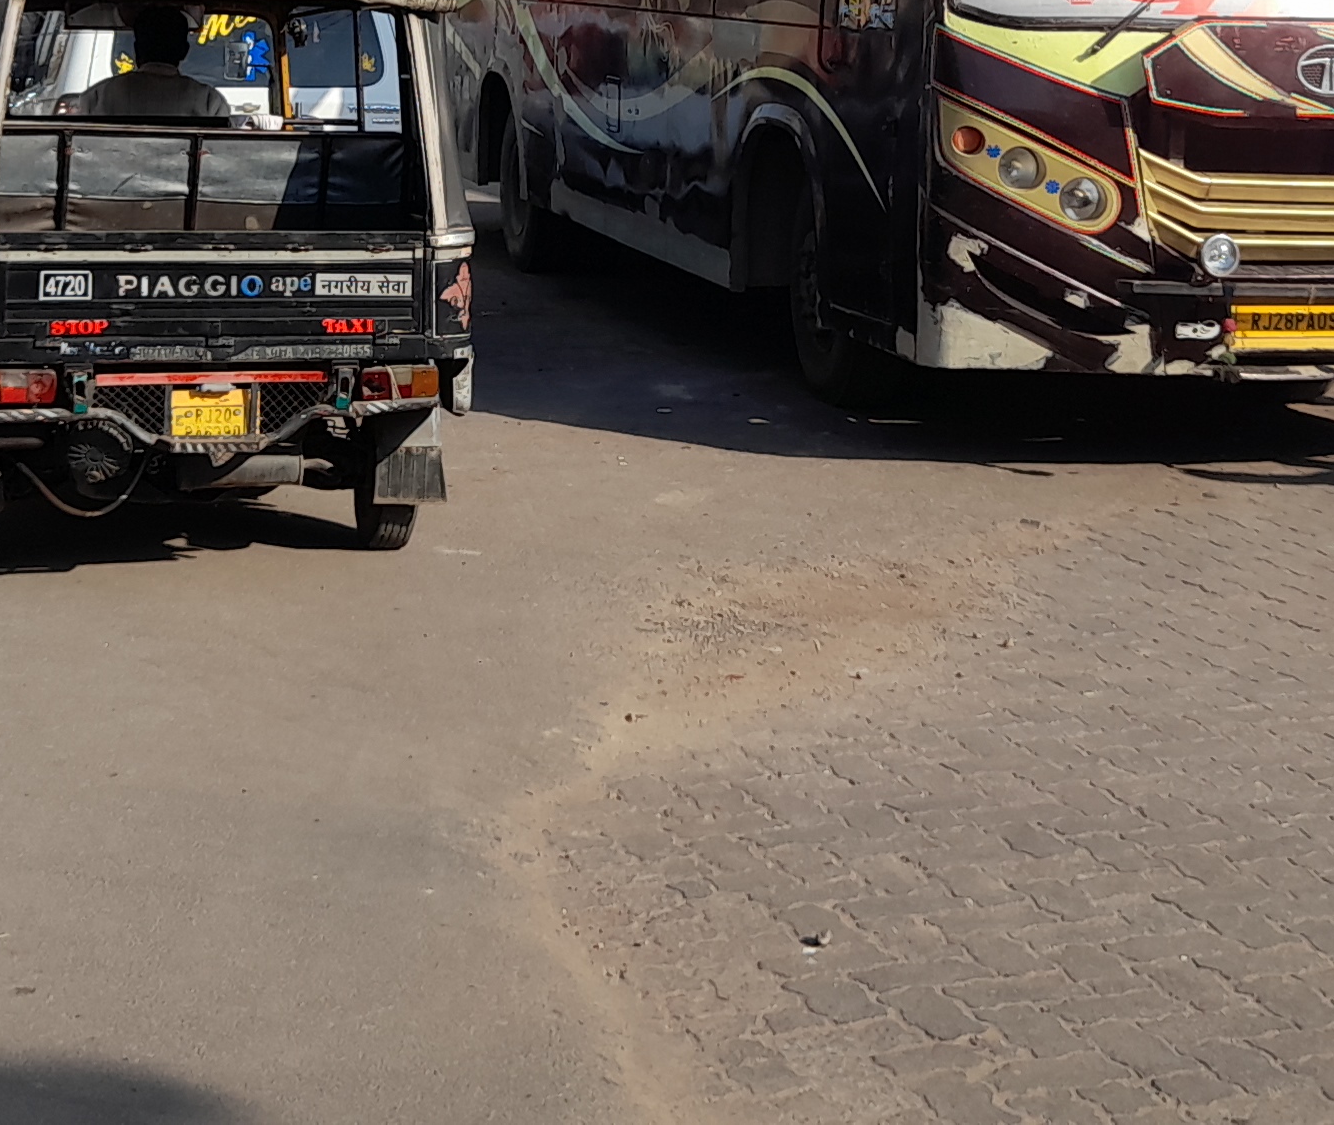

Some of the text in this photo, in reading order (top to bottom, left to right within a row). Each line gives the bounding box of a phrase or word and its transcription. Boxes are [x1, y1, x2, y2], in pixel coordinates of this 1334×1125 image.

[45, 274, 86, 297] 4720
[116, 274, 264, 299] PIAGGIO
[320, 274, 408, 296] नगरीय सेवा
[49, 319, 110, 336] STOP
[322, 318, 375, 334] TAXI
[195, 407, 233, 425] RJ20
